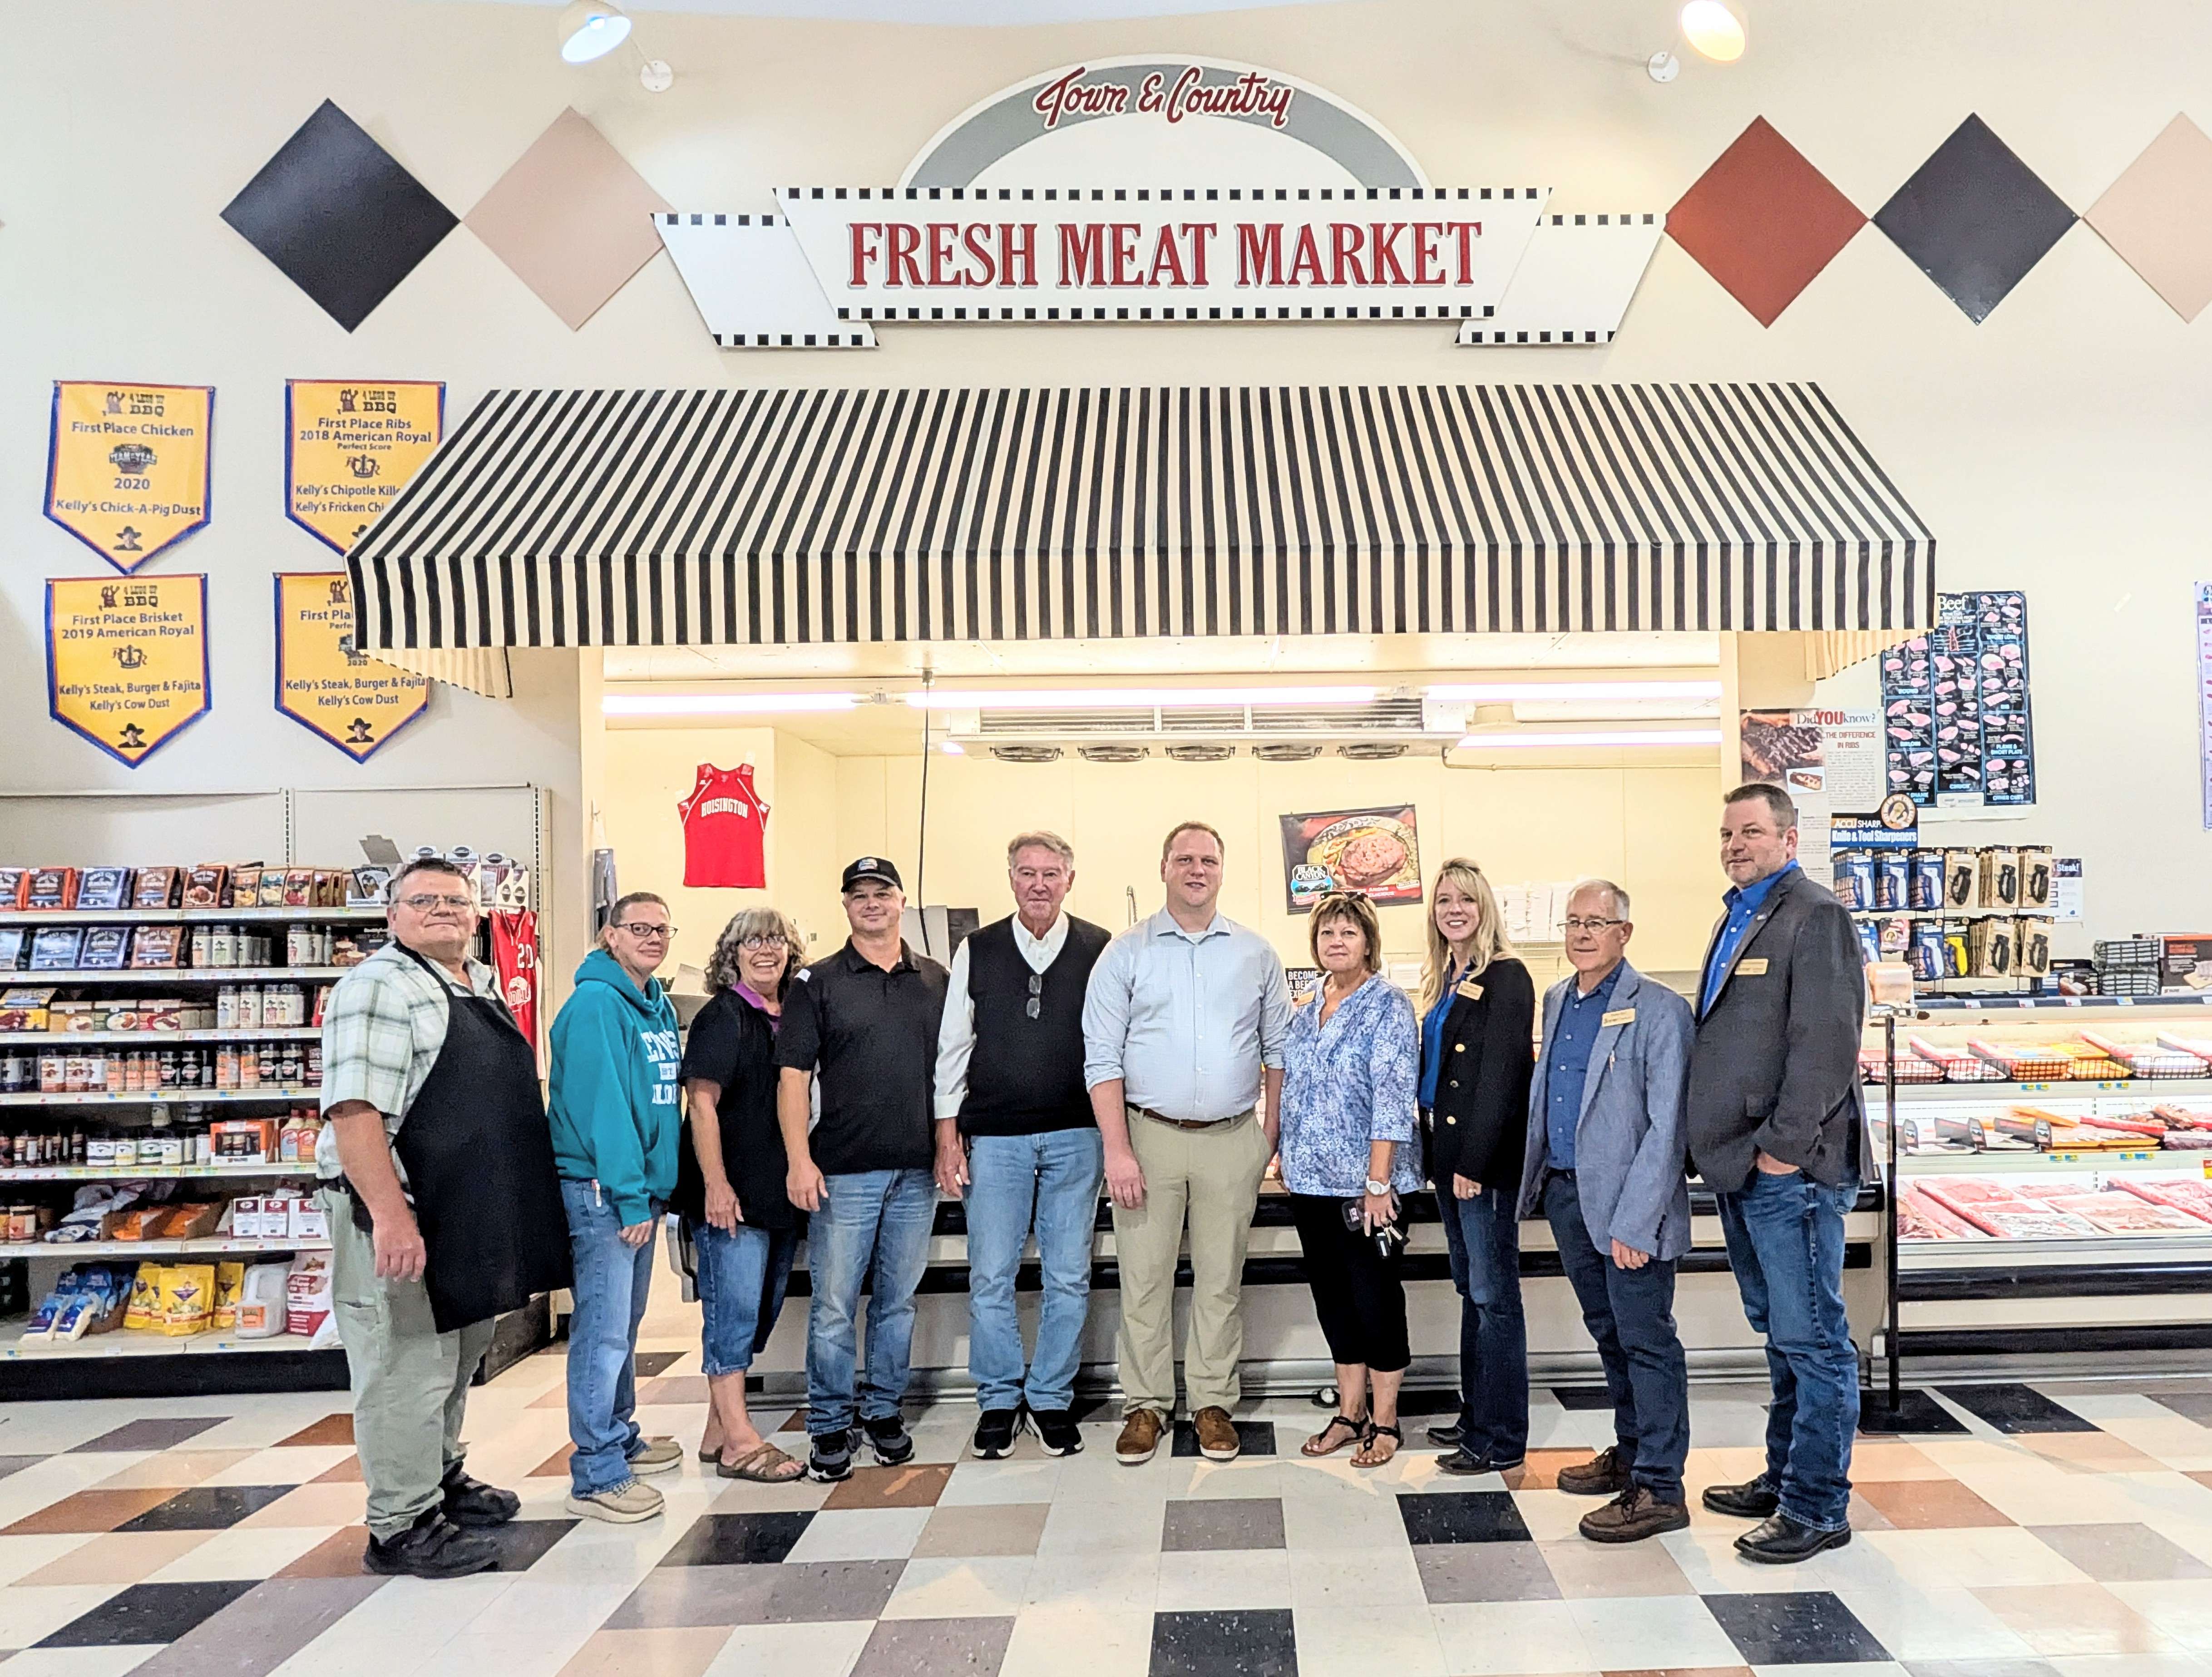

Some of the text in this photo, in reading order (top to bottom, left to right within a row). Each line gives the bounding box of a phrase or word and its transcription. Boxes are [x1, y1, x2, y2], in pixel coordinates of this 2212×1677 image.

[1036, 67, 1291, 126] Town & Country
[847, 222, 1481, 286] FRESH MEAT MARKET
[130, 405, 164, 417] BBQ
[363, 402, 396, 414] BBQ
[72, 421, 194, 436] First Place Chicken
[318, 418, 411, 429] First Place Ribs
[300, 431, 432, 444] 2018 American Royal
[114, 478, 150, 490] 2020
[296, 484, 328, 497] Kelly's
[331, 485, 375, 498] Chipotle
[56, 500, 201, 517] Kelly's Chick-A-Pig Dust
[296, 502, 326, 514] Kelly's
[329, 502, 364, 513] Fricken
[124, 596, 158, 607] BBQ
[1939, 595, 1969, 611] Beef
[73, 612, 183, 626] First Place Brisket
[300, 610, 354, 620] First Pla
[62, 625, 194, 639] 2019 American Royal
[59, 681, 201, 697] Kelly's Steak, Burger & Fajita
[286, 677, 425, 692] Kelly's Steak, Burger & Fajita
[90, 698, 169, 712] Kelly's Cow Dust
[318, 694, 399, 708] Kelly's Cow Dust
[1797, 711, 1875, 725] Did YOU know?
[701, 798, 748, 819] HOISINGTON
[1832, 830, 1851, 842] Knife
[1858, 830, 1874, 842] Tool
[1874, 830, 1917, 843] Sharpeners
[1298, 865, 1323, 875] BLACK
[1288, 971, 1318, 981] BECOME
